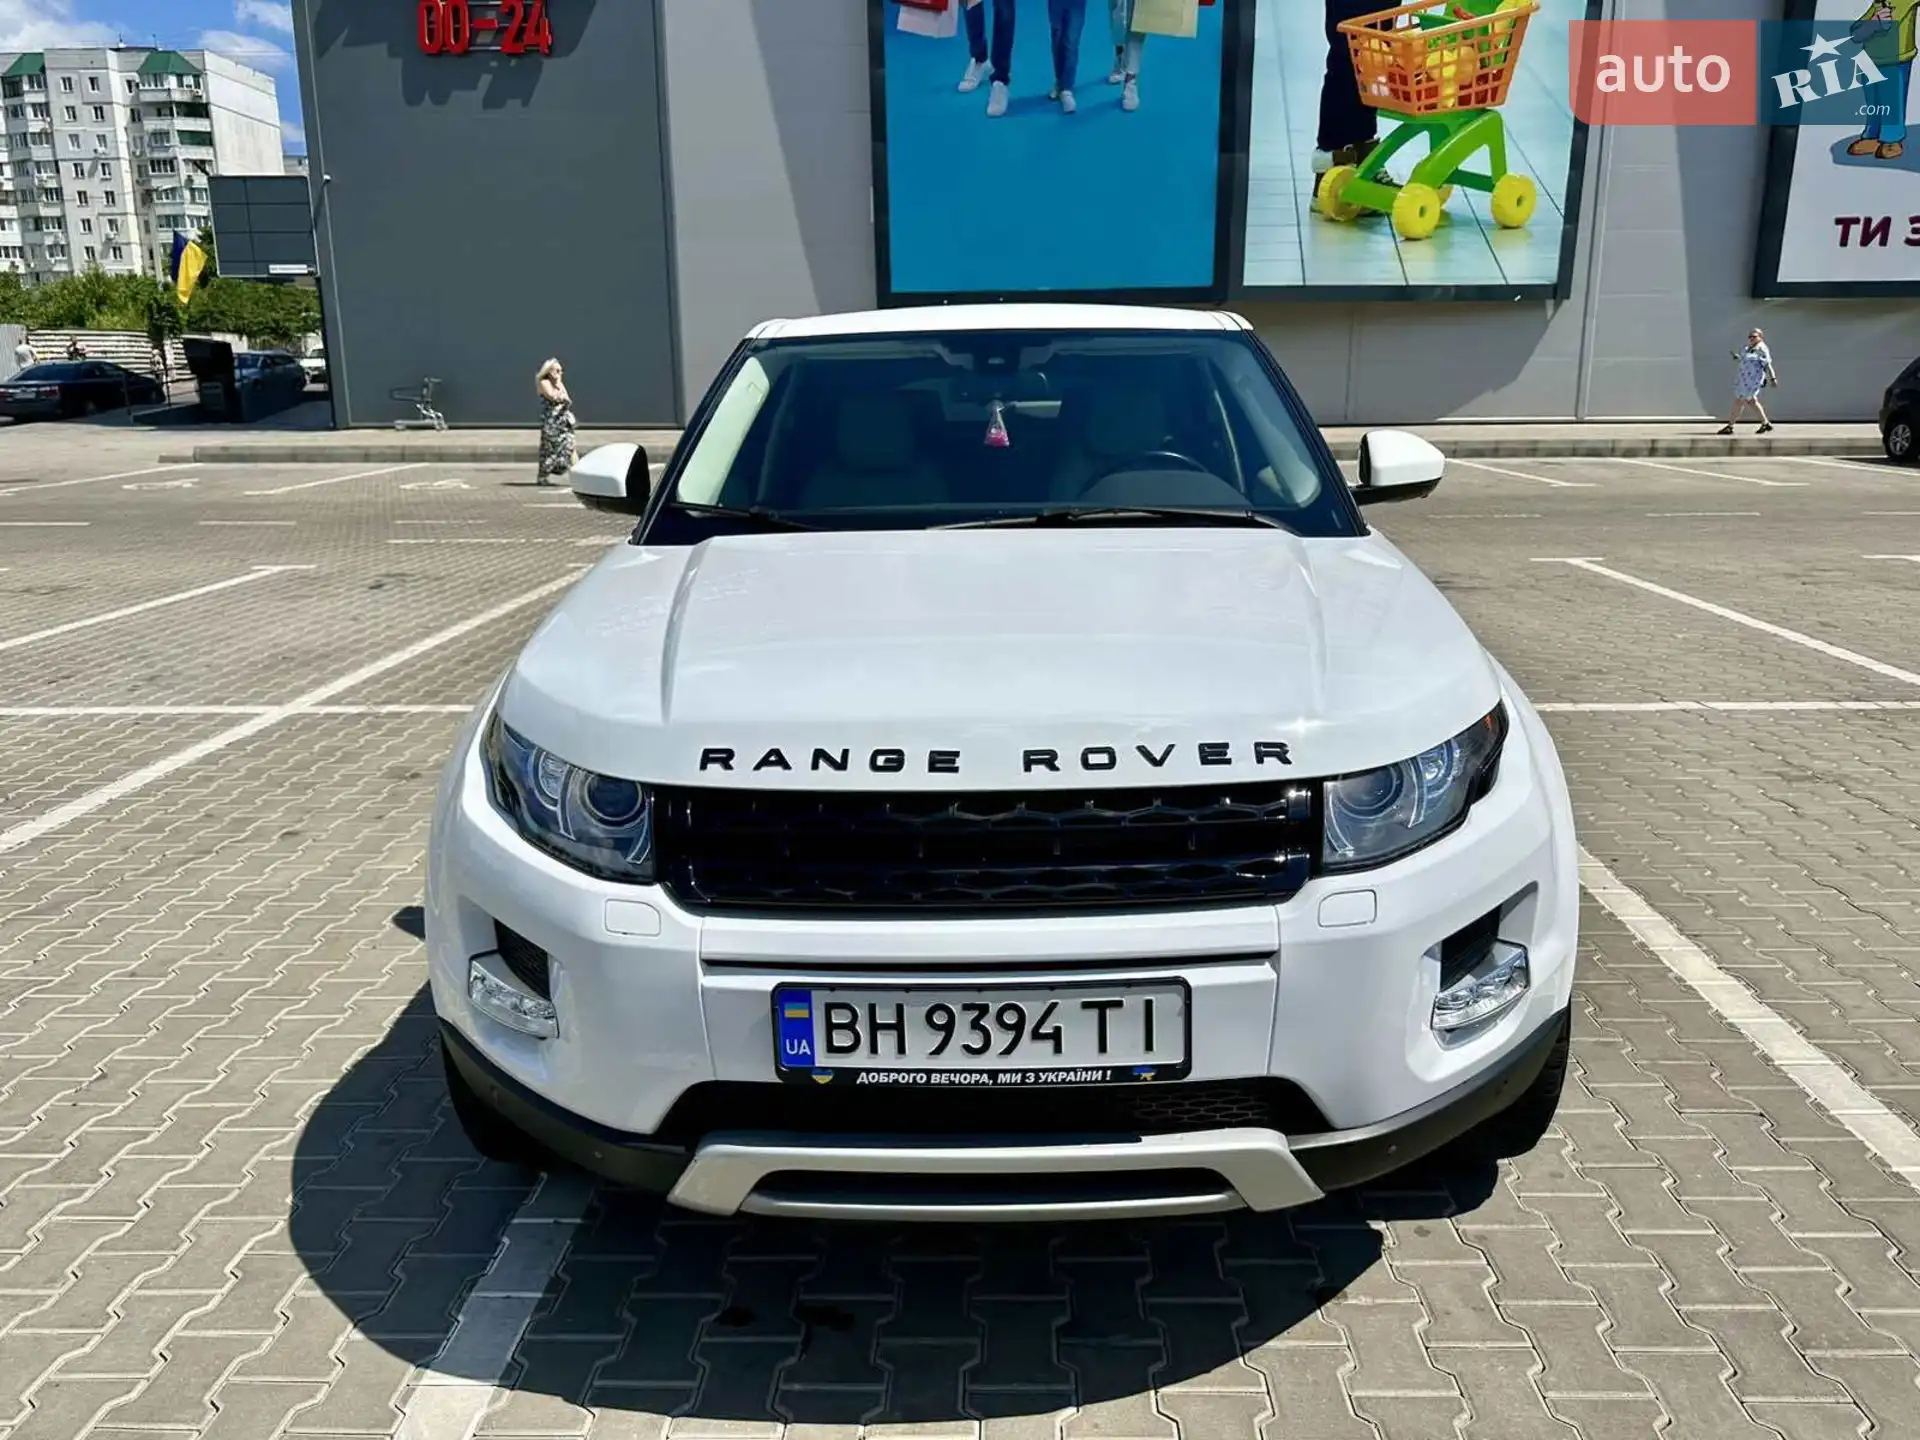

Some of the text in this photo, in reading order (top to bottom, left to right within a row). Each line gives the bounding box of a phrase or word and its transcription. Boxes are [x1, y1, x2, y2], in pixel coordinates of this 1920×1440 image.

[417, 0, 552, 56] 00-24
[1834, 215, 1892, 248] ТИ
[699, 741, 1293, 774] RANGE ROVER
[924, 1000, 1064, 1057] 9394
[785, 1038, 812, 1056] UA
[856, 1071, 927, 1085] ДОБРОГО
[930, 1072, 994, 1086] ВЕЧОРА,
[997, 1071, 1022, 1084] МИ
[1038, 1068, 1103, 1084] УКРАЇНИ
